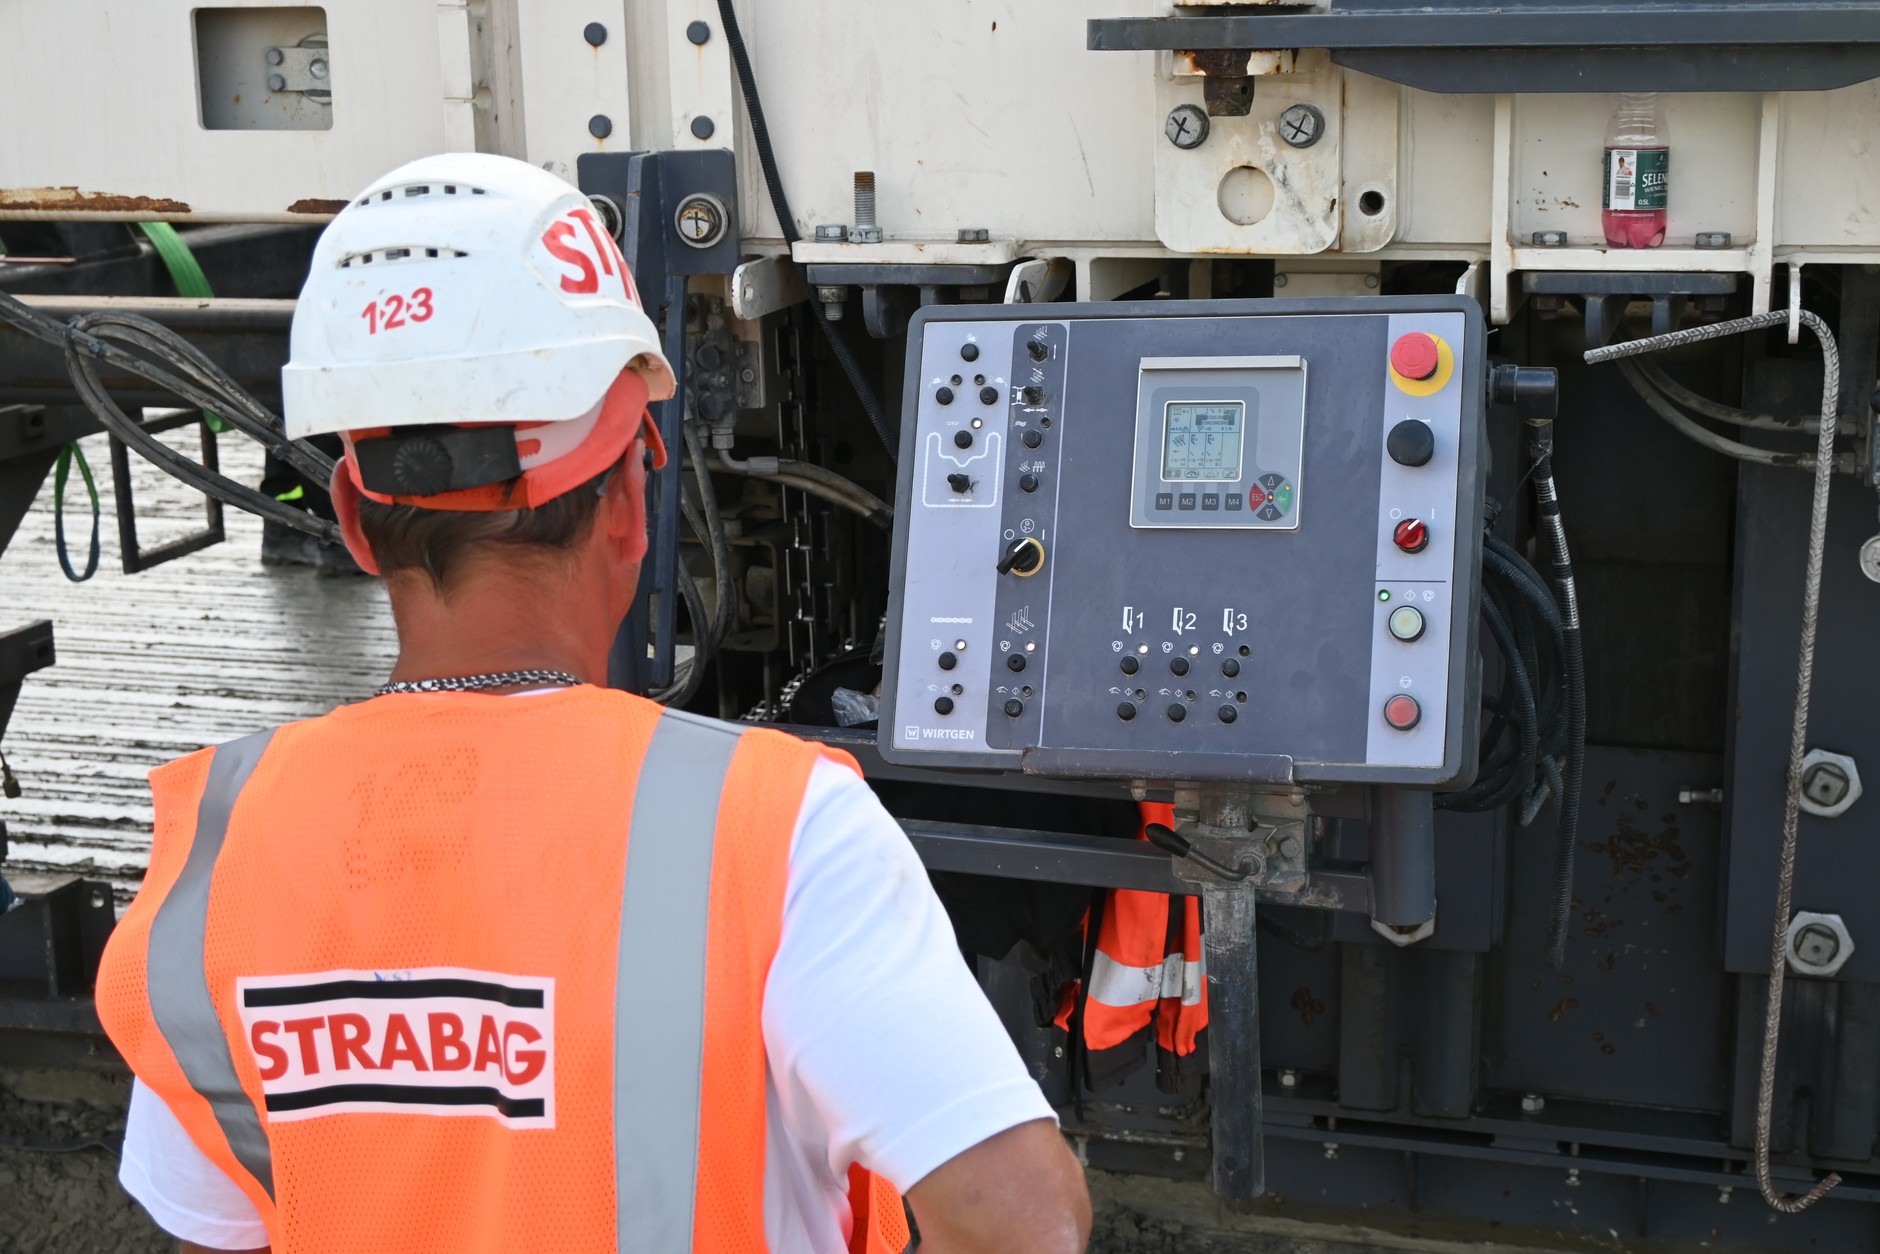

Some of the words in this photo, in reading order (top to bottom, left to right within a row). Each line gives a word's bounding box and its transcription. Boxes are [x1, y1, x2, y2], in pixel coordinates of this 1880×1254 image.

[1252, 493, 1263, 501] ESC
[1136, 612, 1143, 628] 1
[1184, 613, 1196, 630] 2
[1236, 614, 1247, 630] 3
[923, 728, 974, 740] WIRTGEN
[250, 1012, 546, 1086] STRABAG
